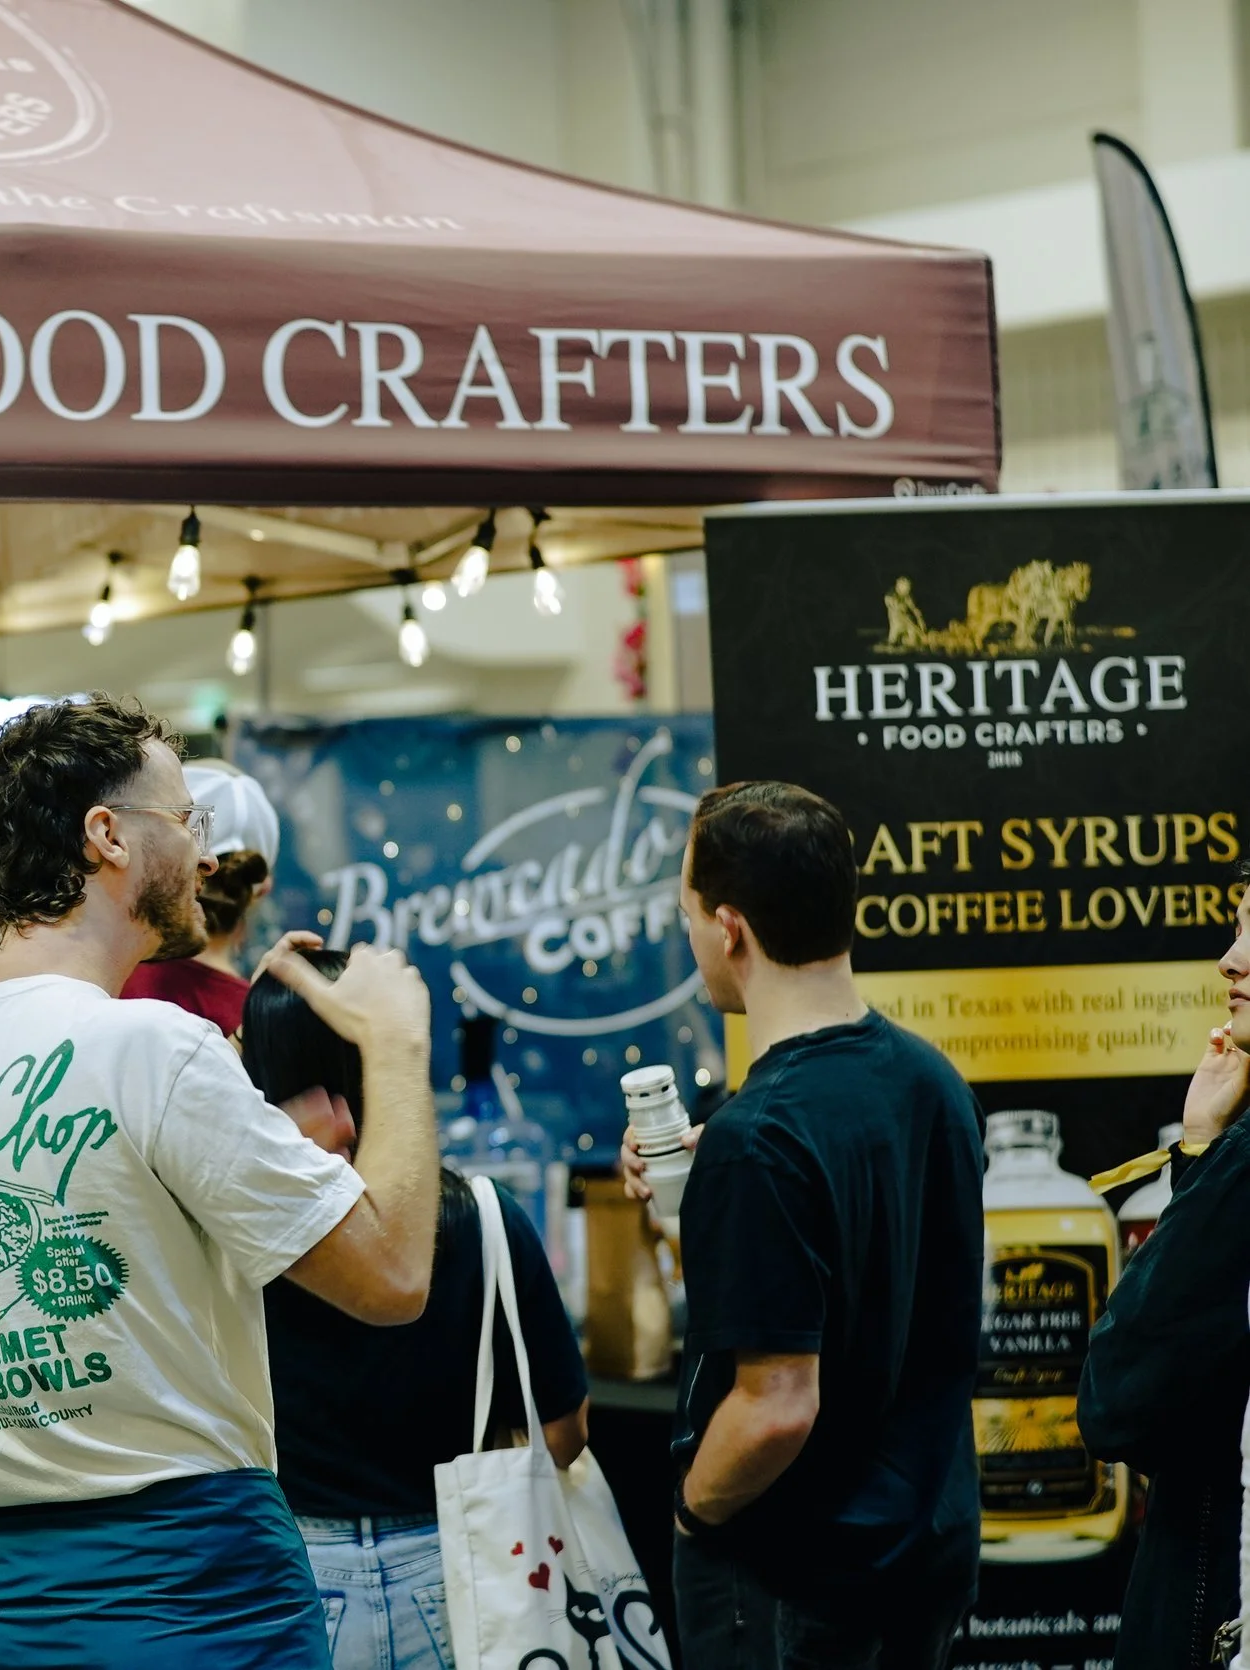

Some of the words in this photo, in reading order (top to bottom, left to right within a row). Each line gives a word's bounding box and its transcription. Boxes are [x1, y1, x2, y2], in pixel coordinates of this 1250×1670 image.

[112, 195, 467, 231] Craftsman
[262, 319, 895, 439] CRAFTERS
[813, 655, 1188, 721] HERITAGE
[882, 723, 966, 750] FOOD
[974, 718, 1124, 748] CRAFTERS
[848, 820, 984, 876] AFT
[1000, 811, 1240, 871] SYRUPS
[855, 887, 1049, 940] COFFEE
[1058, 882, 1248, 932] LOVERS
[525, 885, 692, 974] COFF
[912, 994, 935, 1018] in
[946, 993, 1013, 1016] Texas
[1021, 988, 1075, 1014] with
[1081, 985, 1125, 1011] real
[1133, 982, 1228, 1015] ingredie
[932, 1027, 1090, 1058] ompromising
[46, 1244, 85, 1259] Special
[31, 1262, 113, 1297] $8.50
[38, 1403, 94, 1428] COUNTY
[1093, 1613, 1122, 1635] an
